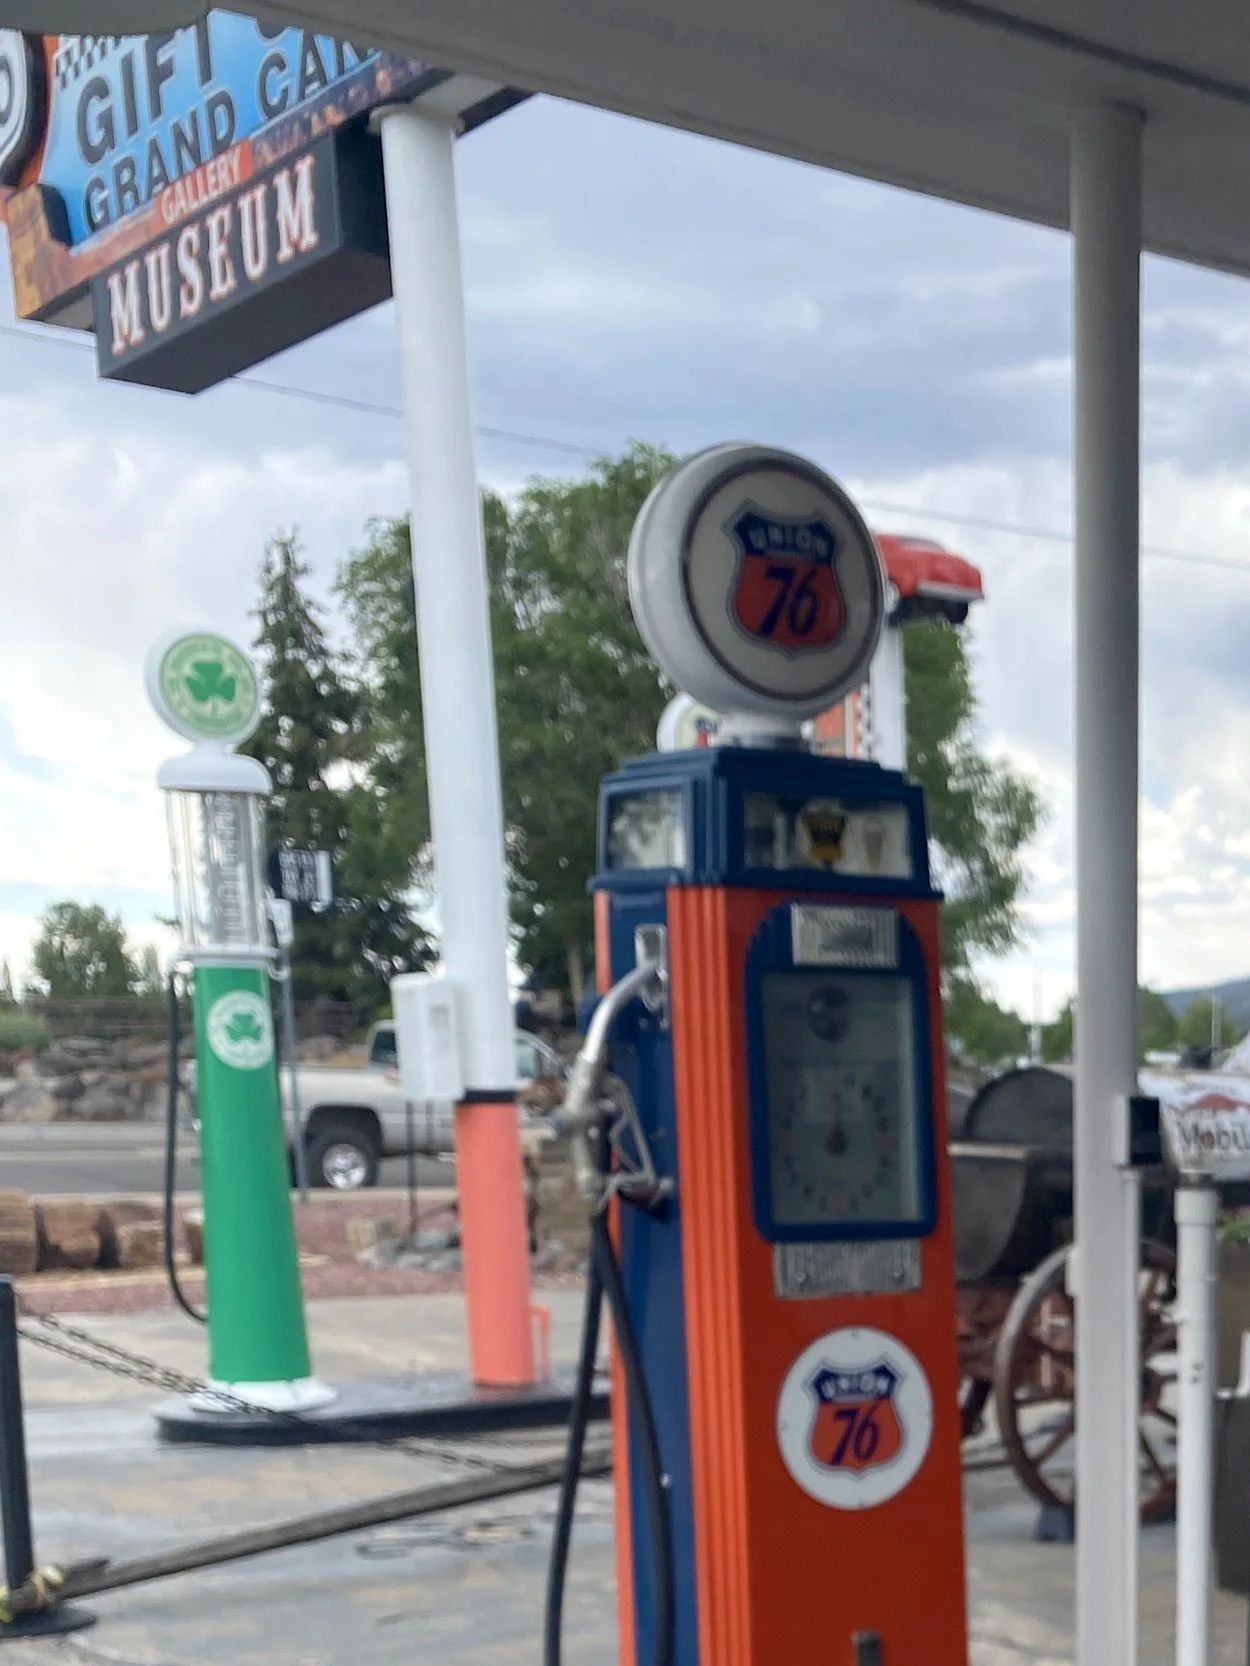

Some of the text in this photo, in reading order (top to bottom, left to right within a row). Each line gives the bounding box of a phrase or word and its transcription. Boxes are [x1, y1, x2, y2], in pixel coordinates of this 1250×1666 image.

[85, 90, 236, 234] GRAND
[160, 150, 242, 224] GALLERY
[107, 153, 319, 356] MUSEUM
[758, 565, 818, 637] 76
[829, 1402, 881, 1467] 76
